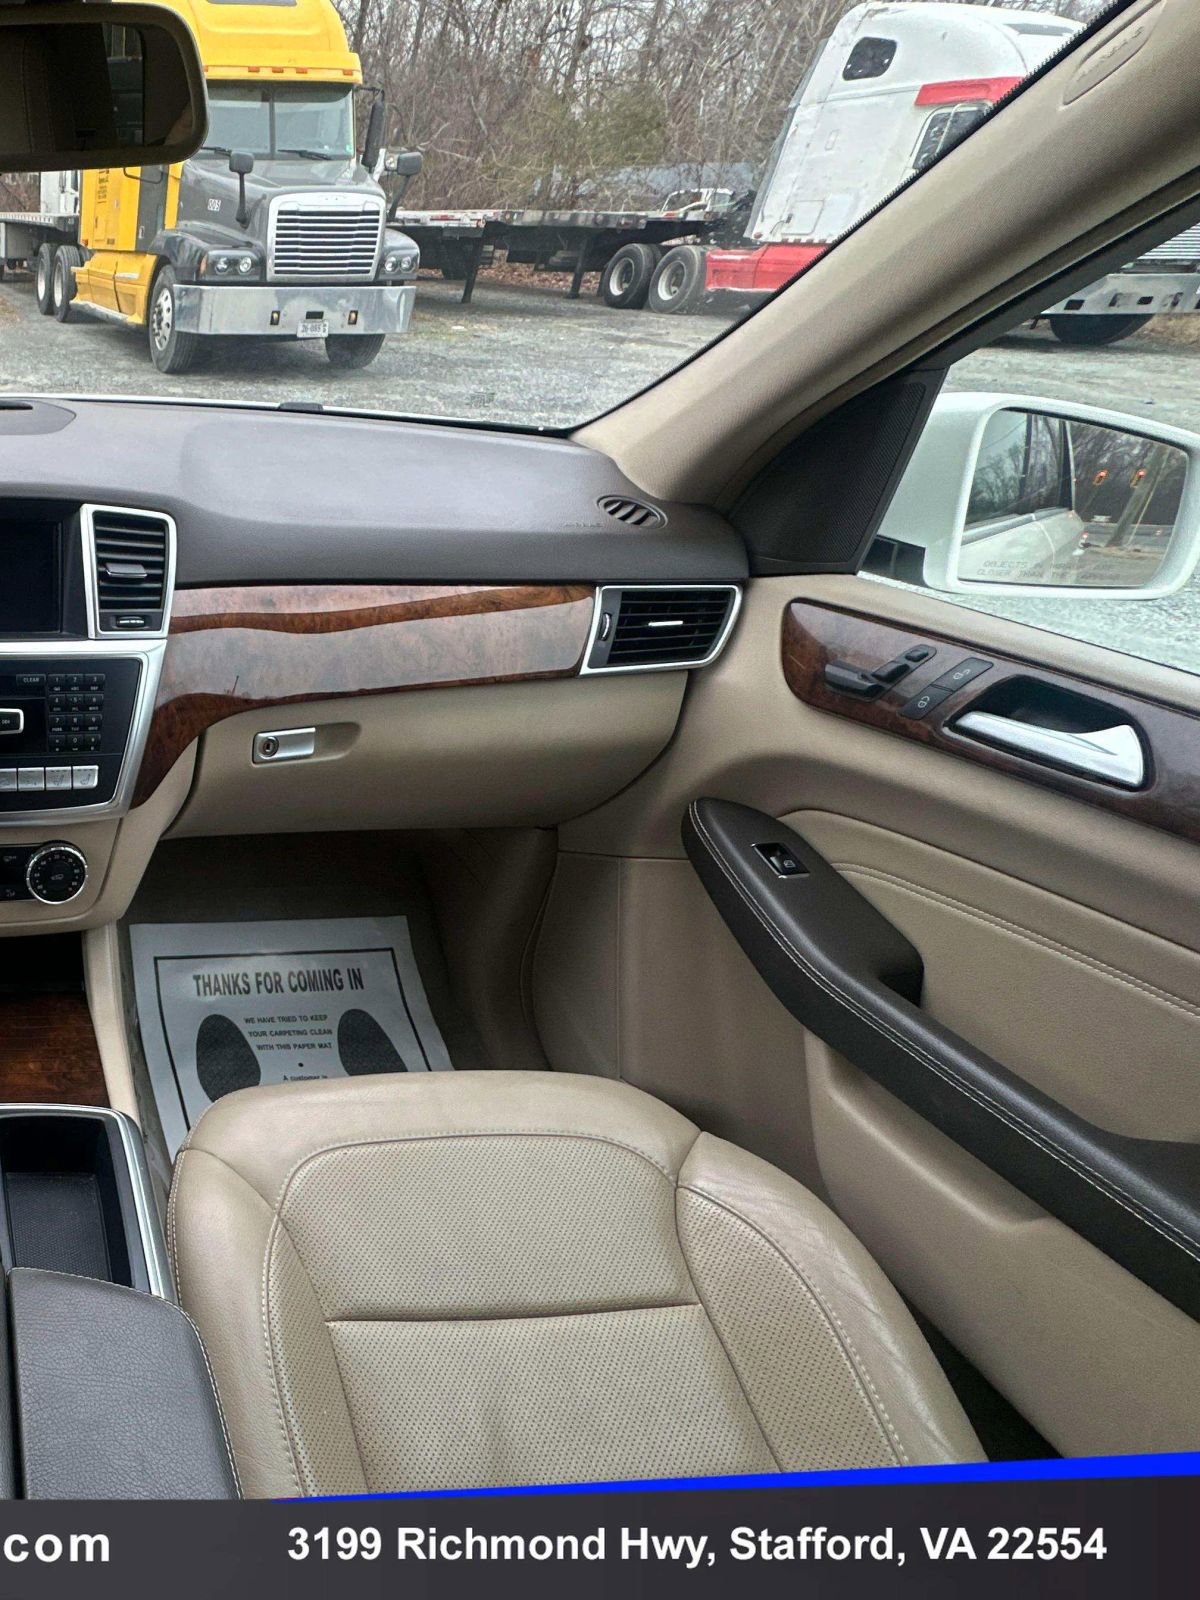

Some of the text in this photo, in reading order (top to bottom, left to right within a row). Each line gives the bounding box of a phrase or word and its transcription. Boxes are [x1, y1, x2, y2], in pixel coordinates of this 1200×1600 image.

[193, 968, 364, 996] THANKS FOR COMING IN
[257, 1016, 275, 1024] HAVE
[277, 1015, 297, 1023] TRIED
[248, 1028, 333, 1038] YOUR CARPETING CLEAN
